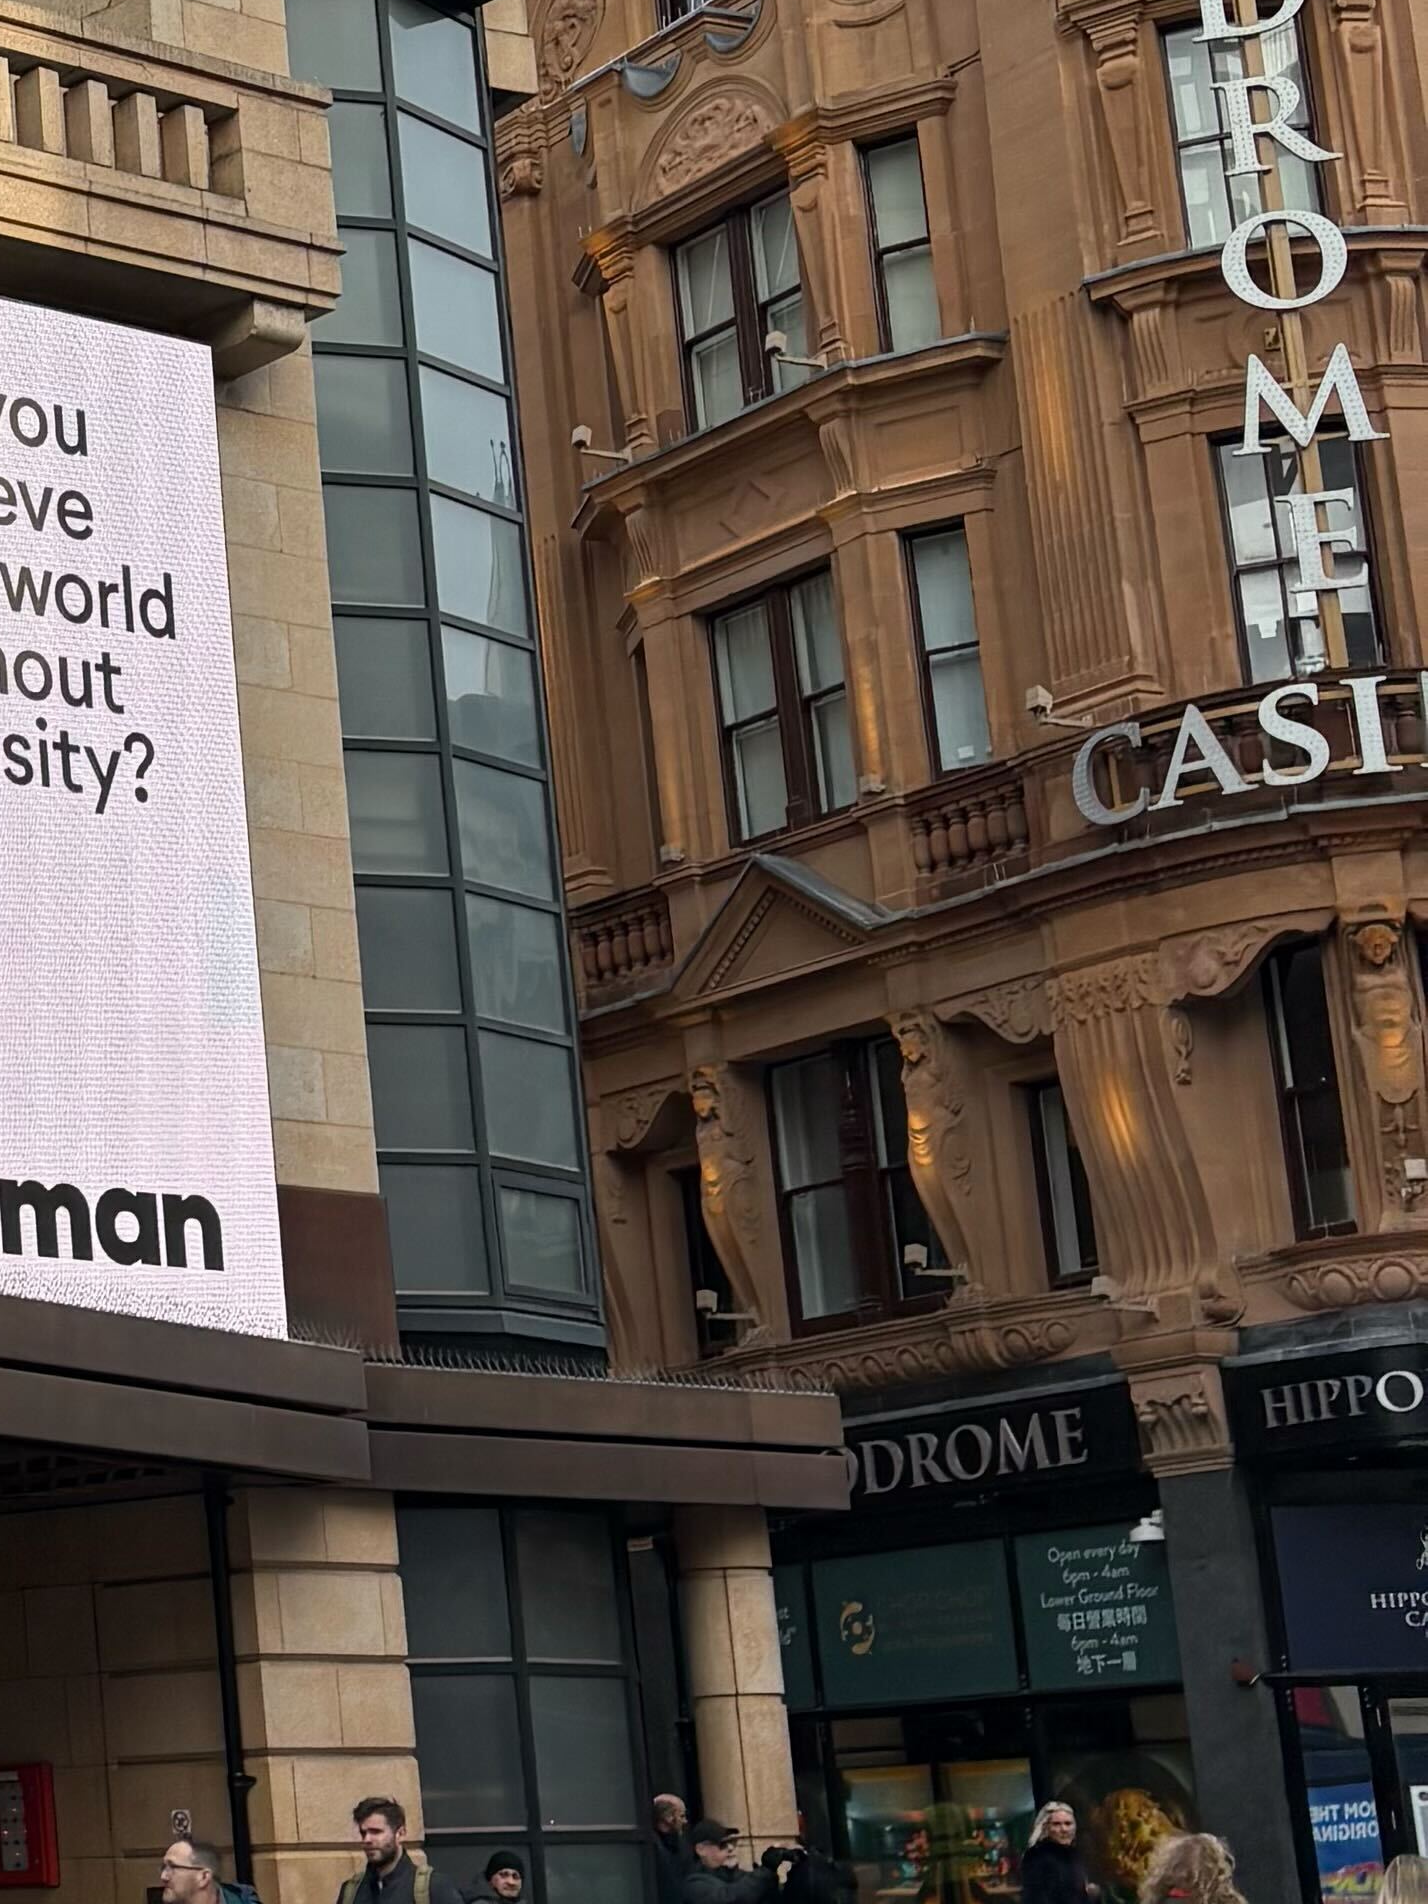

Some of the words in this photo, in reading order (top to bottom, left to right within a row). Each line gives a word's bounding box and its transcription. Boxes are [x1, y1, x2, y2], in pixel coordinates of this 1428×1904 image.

[1072, 670, 1428, 827] CASI
[1259, 1369, 1428, 1429] HIPPO
[1047, 1546, 1082, 1567] Open
[1078, 1585, 1124, 1604] Ground
